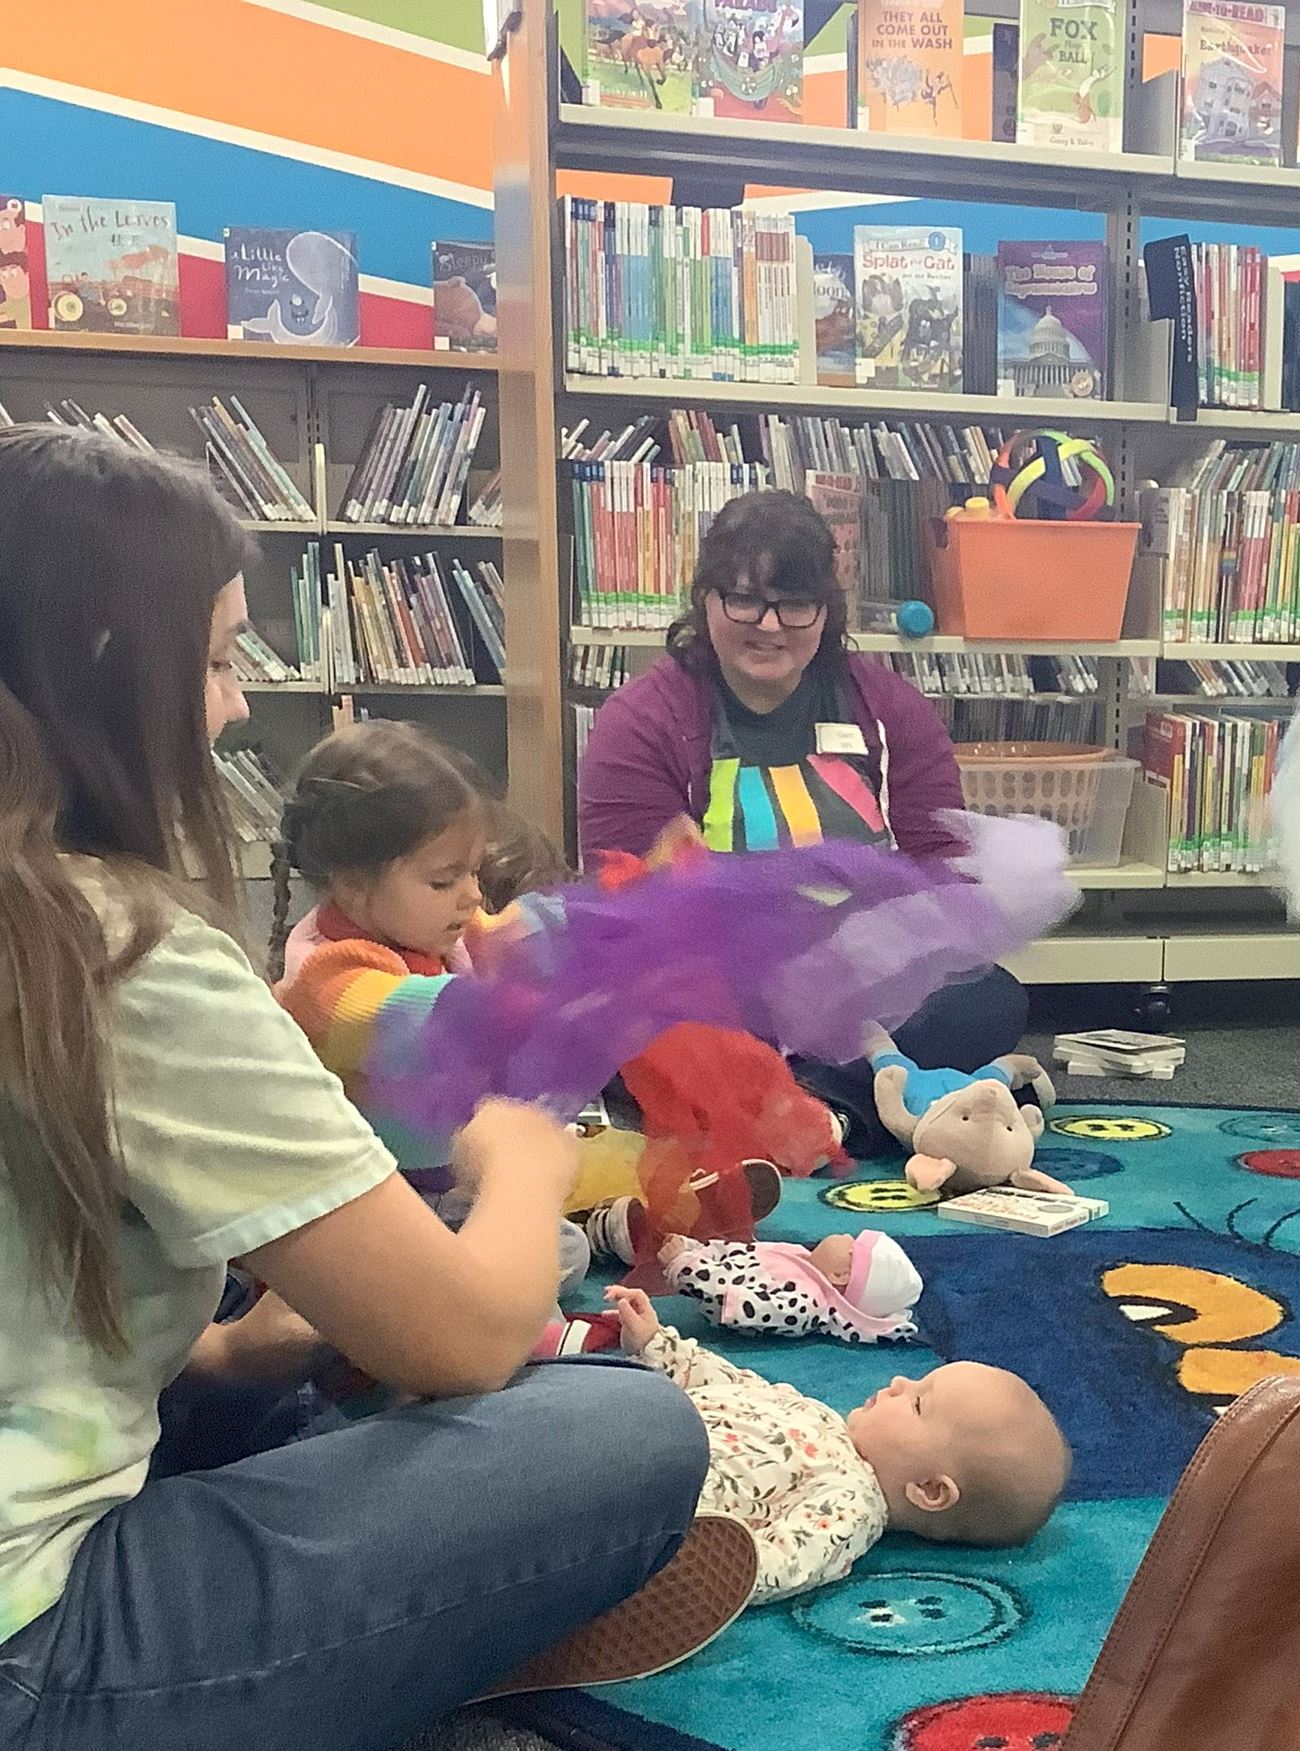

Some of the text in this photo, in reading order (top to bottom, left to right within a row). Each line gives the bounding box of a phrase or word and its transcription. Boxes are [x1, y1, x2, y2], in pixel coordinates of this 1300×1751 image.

[882, 10, 943, 23] THEY ALL
[876, 24, 948, 36] COME OUT
[1050, 17, 1098, 41] FOX
[911, 37, 953, 49] WASH
[1059, 50, 1087, 64] BALL
[50, 221, 74, 241] In
[81, 205, 108, 233] the
[240, 242, 282, 261] Little
[863, 254, 908, 270] Splat
[924, 255, 955, 271] Cat
